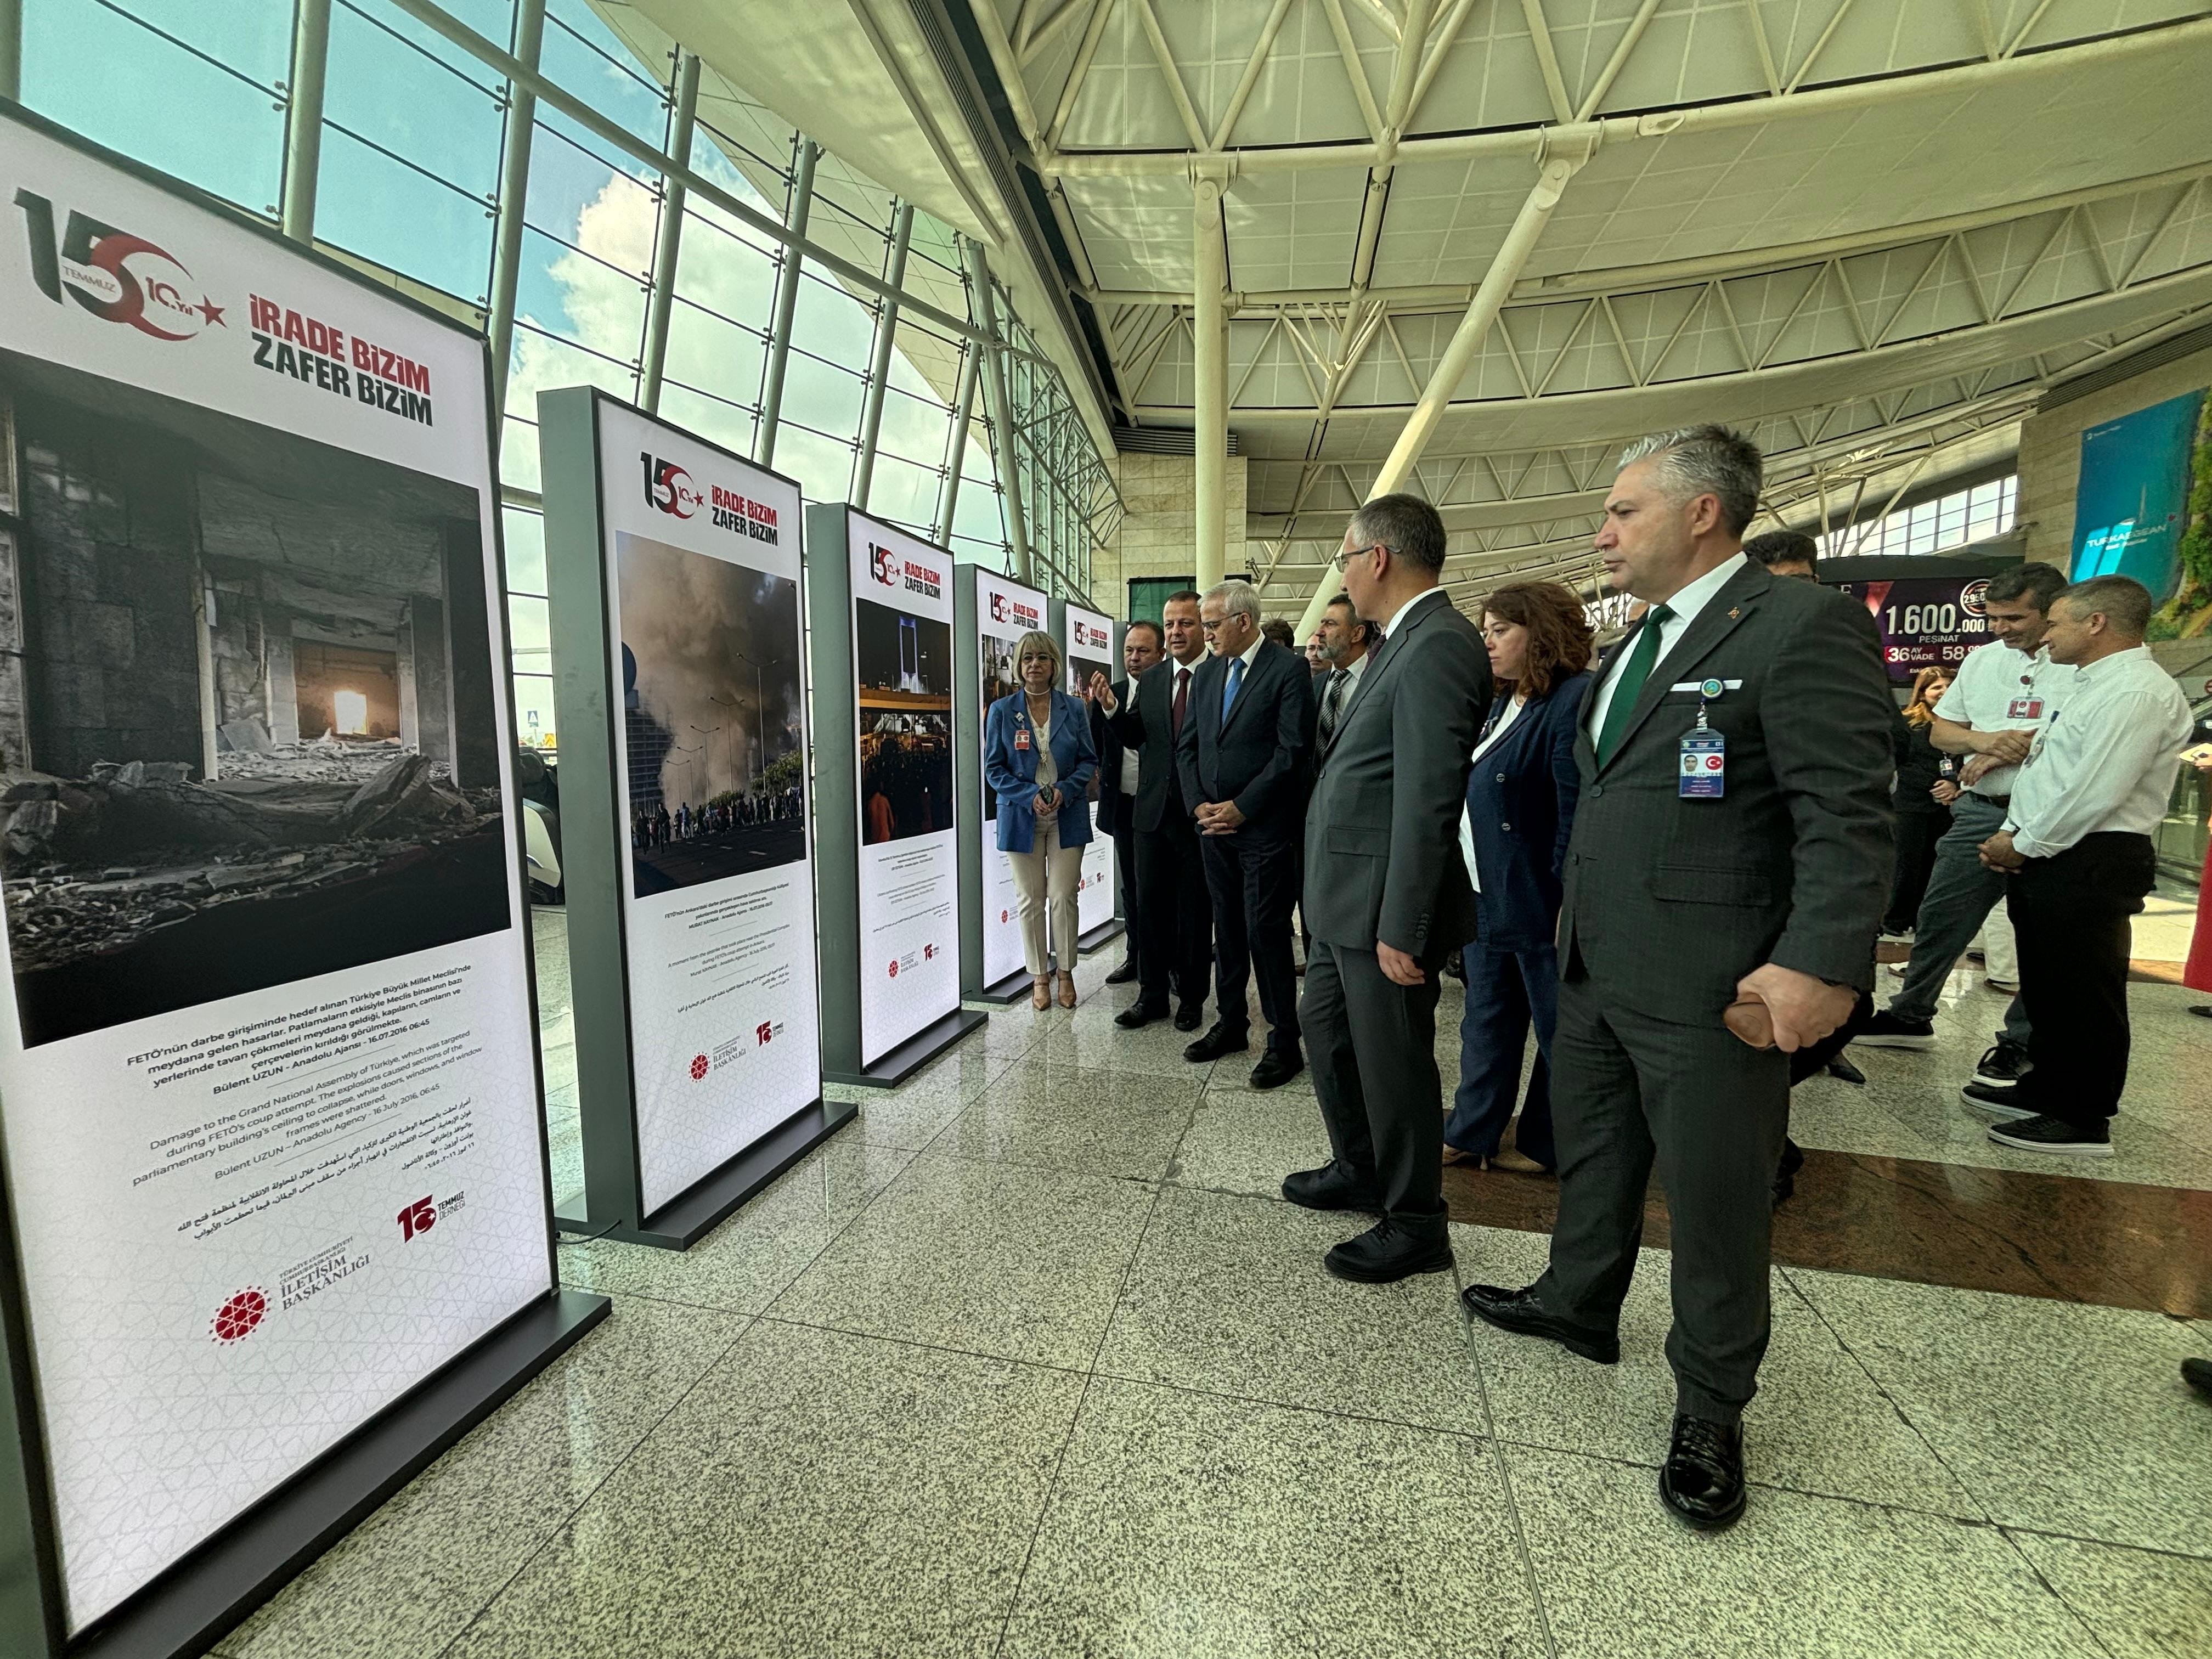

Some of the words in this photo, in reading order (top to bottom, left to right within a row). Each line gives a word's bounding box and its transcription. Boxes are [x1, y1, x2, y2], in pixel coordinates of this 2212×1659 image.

[63, 264, 116, 293] TEMMUZ
[251, 331, 351, 398] ZAFER
[712, 506, 747, 536] ZAFER
[905, 576, 923, 595] ZAFER
[1013, 614, 1026, 628] ZAFER
[1888, 647, 1910, 662] 36
[127, 1043, 188, 1066] FETÖ'nün
[190, 1034, 225, 1048] darbe
[227, 1016, 287, 1039] girişiminde
[289, 1006, 318, 1020] hedef
[319, 1000, 348, 1012] alınan
[348, 990, 381, 1003] Türkiye
[382, 981, 409, 995] Büyük
[410, 975, 432, 987] Millet
[148, 1052, 205, 1074] meydana
[207, 1042, 240, 1058] gelen
[288, 1011, 348, 1033] Patlamaların
[349, 1000, 385, 1015] etkisiyle
[386, 992, 412, 1005] Meclis
[413, 983, 447, 997] binasının
[448, 978, 462, 986] bazı
[153, 1063, 215, 1089] yerlerinde
[216, 1053, 248, 1067] tavan
[250, 1034, 301, 1059] çökmeleri
[303, 1023, 347, 1041] meydana
[419, 992, 452, 1006] camların
[213, 1077, 251, 1095] Bülent
[252, 1065, 284, 1081] UZUN
[291, 1051, 332, 1069] Anadolu
[334, 1042, 362, 1056] Ajansı
[368, 1025, 408, 1044] 16.07.2016
[409, 1018, 430, 1030] 06:45
[251, 1045, 313, 1071] çerçevelerin
[314, 1033, 349, 1049] kırıldığı
[133, 1148, 216, 1187] parliamentary
[218, 1127, 270, 1152] building's
[271, 1114, 304, 1131] ceiling
[357, 1086, 380, 1099] while
[441, 1056, 455, 1067] and
[456, 1047, 482, 1060] window
[150, 1127, 201, 1150] Damage
[202, 1122, 216, 1131] to
[217, 1114, 236, 1125] the
[238, 1100, 271, 1118] Grand
[273, 1085, 314, 1105] National
[315, 1071, 358, 1091] Assembly
[359, 1065, 369, 1075] of
[401, 1047, 425, 1059] which
[425, 1042, 440, 1051] was
[441, 1030, 470, 1046] targeted
[166, 1138, 206, 1158] during
[208, 1124, 245, 1142] FETÖ's
[247, 1114, 274, 1127] coup
[318, 1091, 336, 1101] The
[337, 1074, 382, 1094] explosions
[382, 1062, 411, 1077] caused
[411, 1052, 442, 1067] sections
[442, 1047, 450, 1056] of
[450, 1044, 463, 1052] the
[215, 1160, 251, 1180] Bülent
[253, 1146, 284, 1163] UZUN
[292, 1127, 332, 1148] Anadolu
[334, 1114, 367, 1132] Agency
[373, 1106, 382, 1115] 16
[383, 1101, 399, 1111] July
[419, 1083, 440, 1096] 06:45
[286, 1120, 320, 1138] frames
[321, 1111, 344, 1124] were
[438, 1191, 465, 1211] TEMMUZ
[281, 1256, 347, 1298] İLETİŞİM
[283, 1254, 370, 1311] BAŞKANLIĞI
